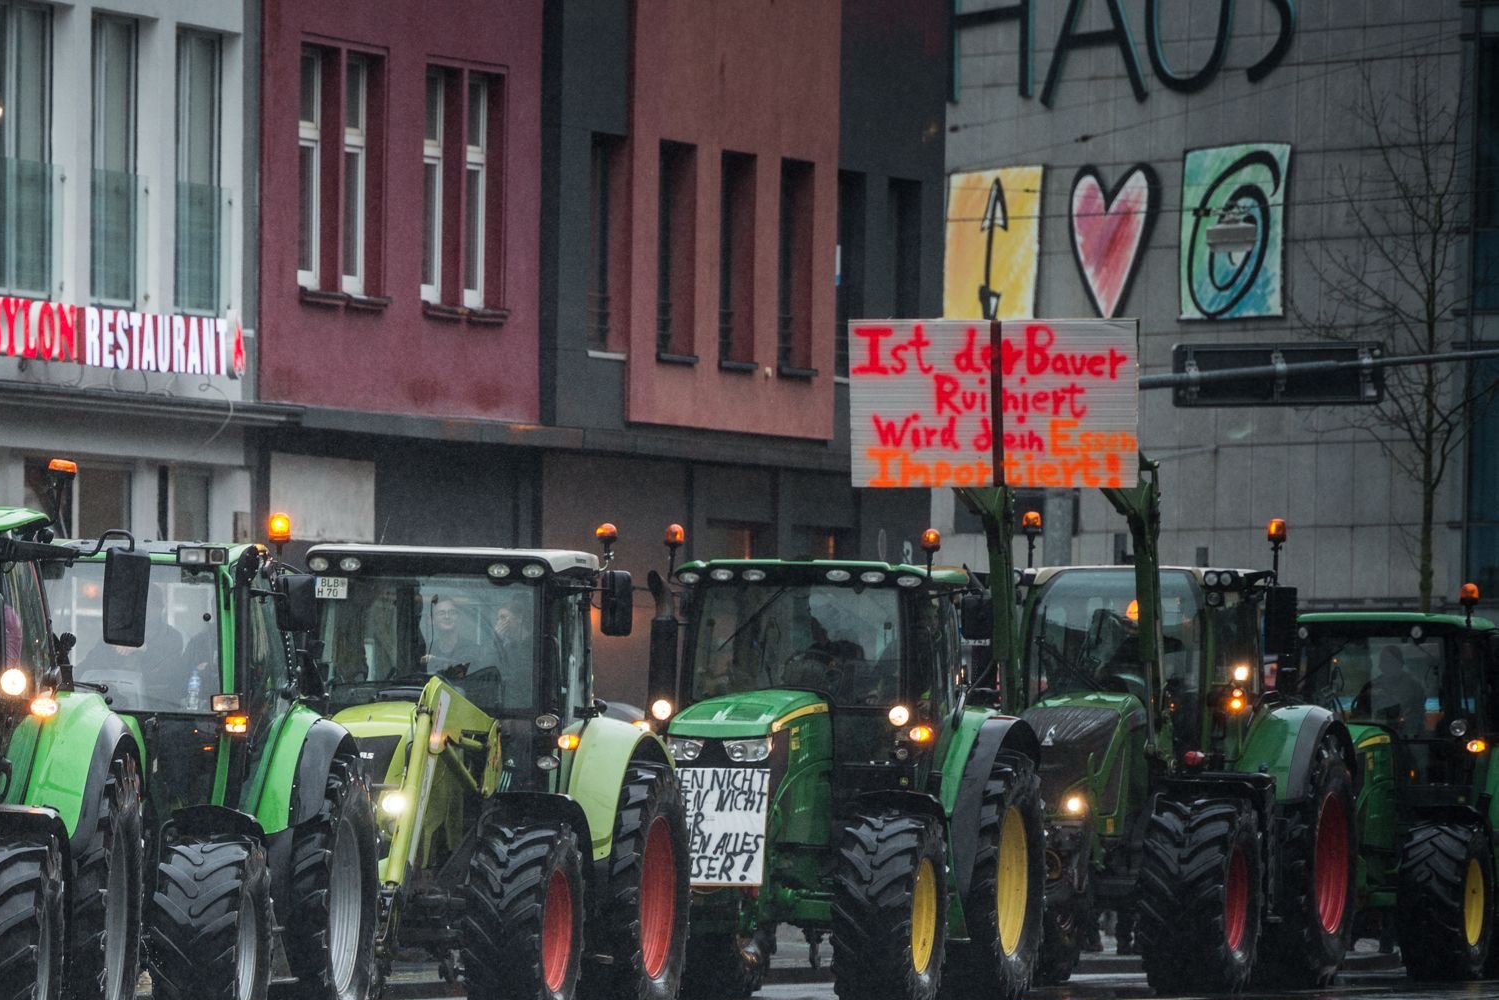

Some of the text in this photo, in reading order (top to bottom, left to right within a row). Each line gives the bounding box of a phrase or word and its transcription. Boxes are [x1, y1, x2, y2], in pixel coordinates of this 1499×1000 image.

[85, 307, 228, 375] RESTAURANT
[852, 324, 933, 374] Ist
[1025, 325, 1128, 379] Bauer
[933, 373, 1087, 419] Ruiniert
[872, 413, 1137, 456] Wird dein Essen
[866, 447, 1122, 488] Importiert!
[317, 588, 338, 597] H 70
[321, 578, 339, 588] BLB
[676, 769, 769, 791] EN NICHT
[715, 789, 767, 813] NICHT
[713, 832, 764, 857] ALLES
